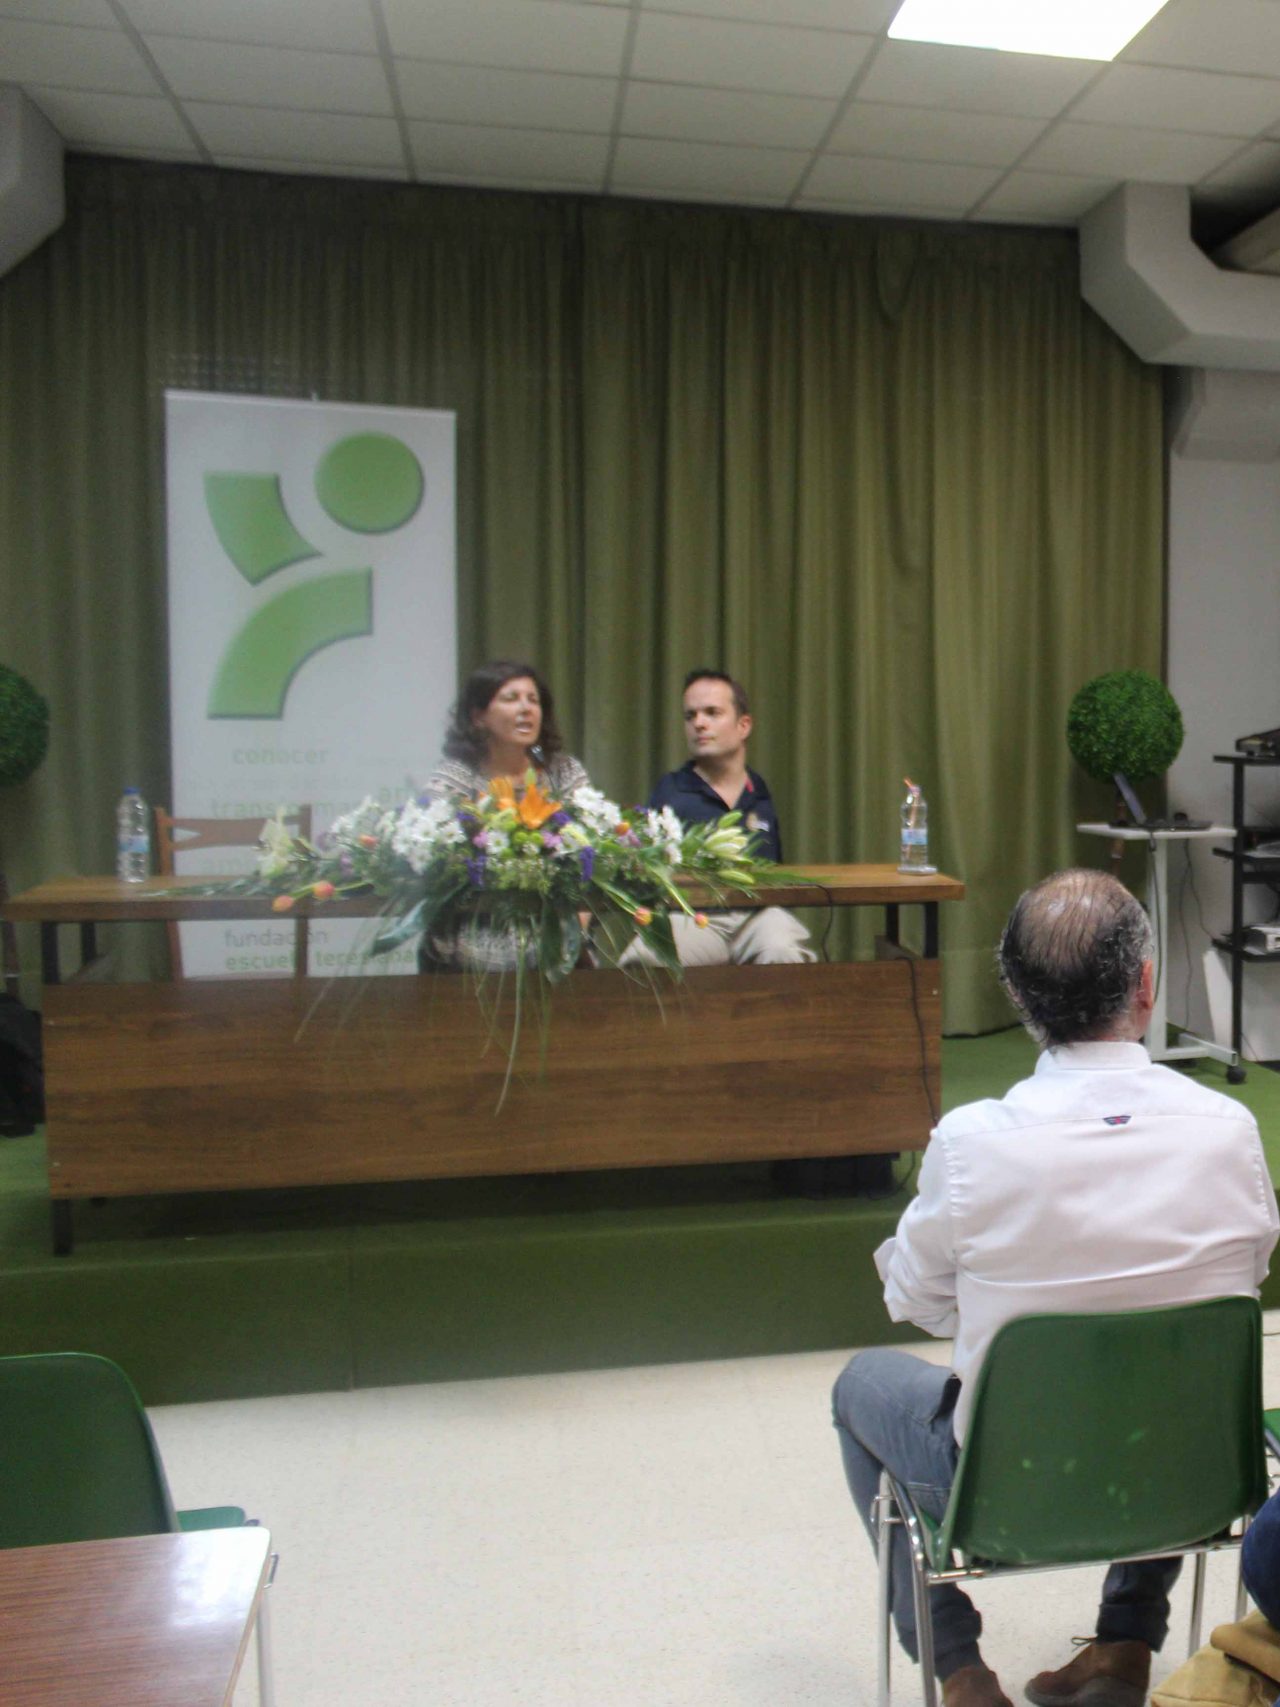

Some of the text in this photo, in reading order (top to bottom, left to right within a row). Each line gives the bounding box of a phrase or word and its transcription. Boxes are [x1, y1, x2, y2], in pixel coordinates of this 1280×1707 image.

[232, 748, 328, 765] conocer
[224, 929, 328, 949] fundacn
[225, 949, 300, 970] escuel
